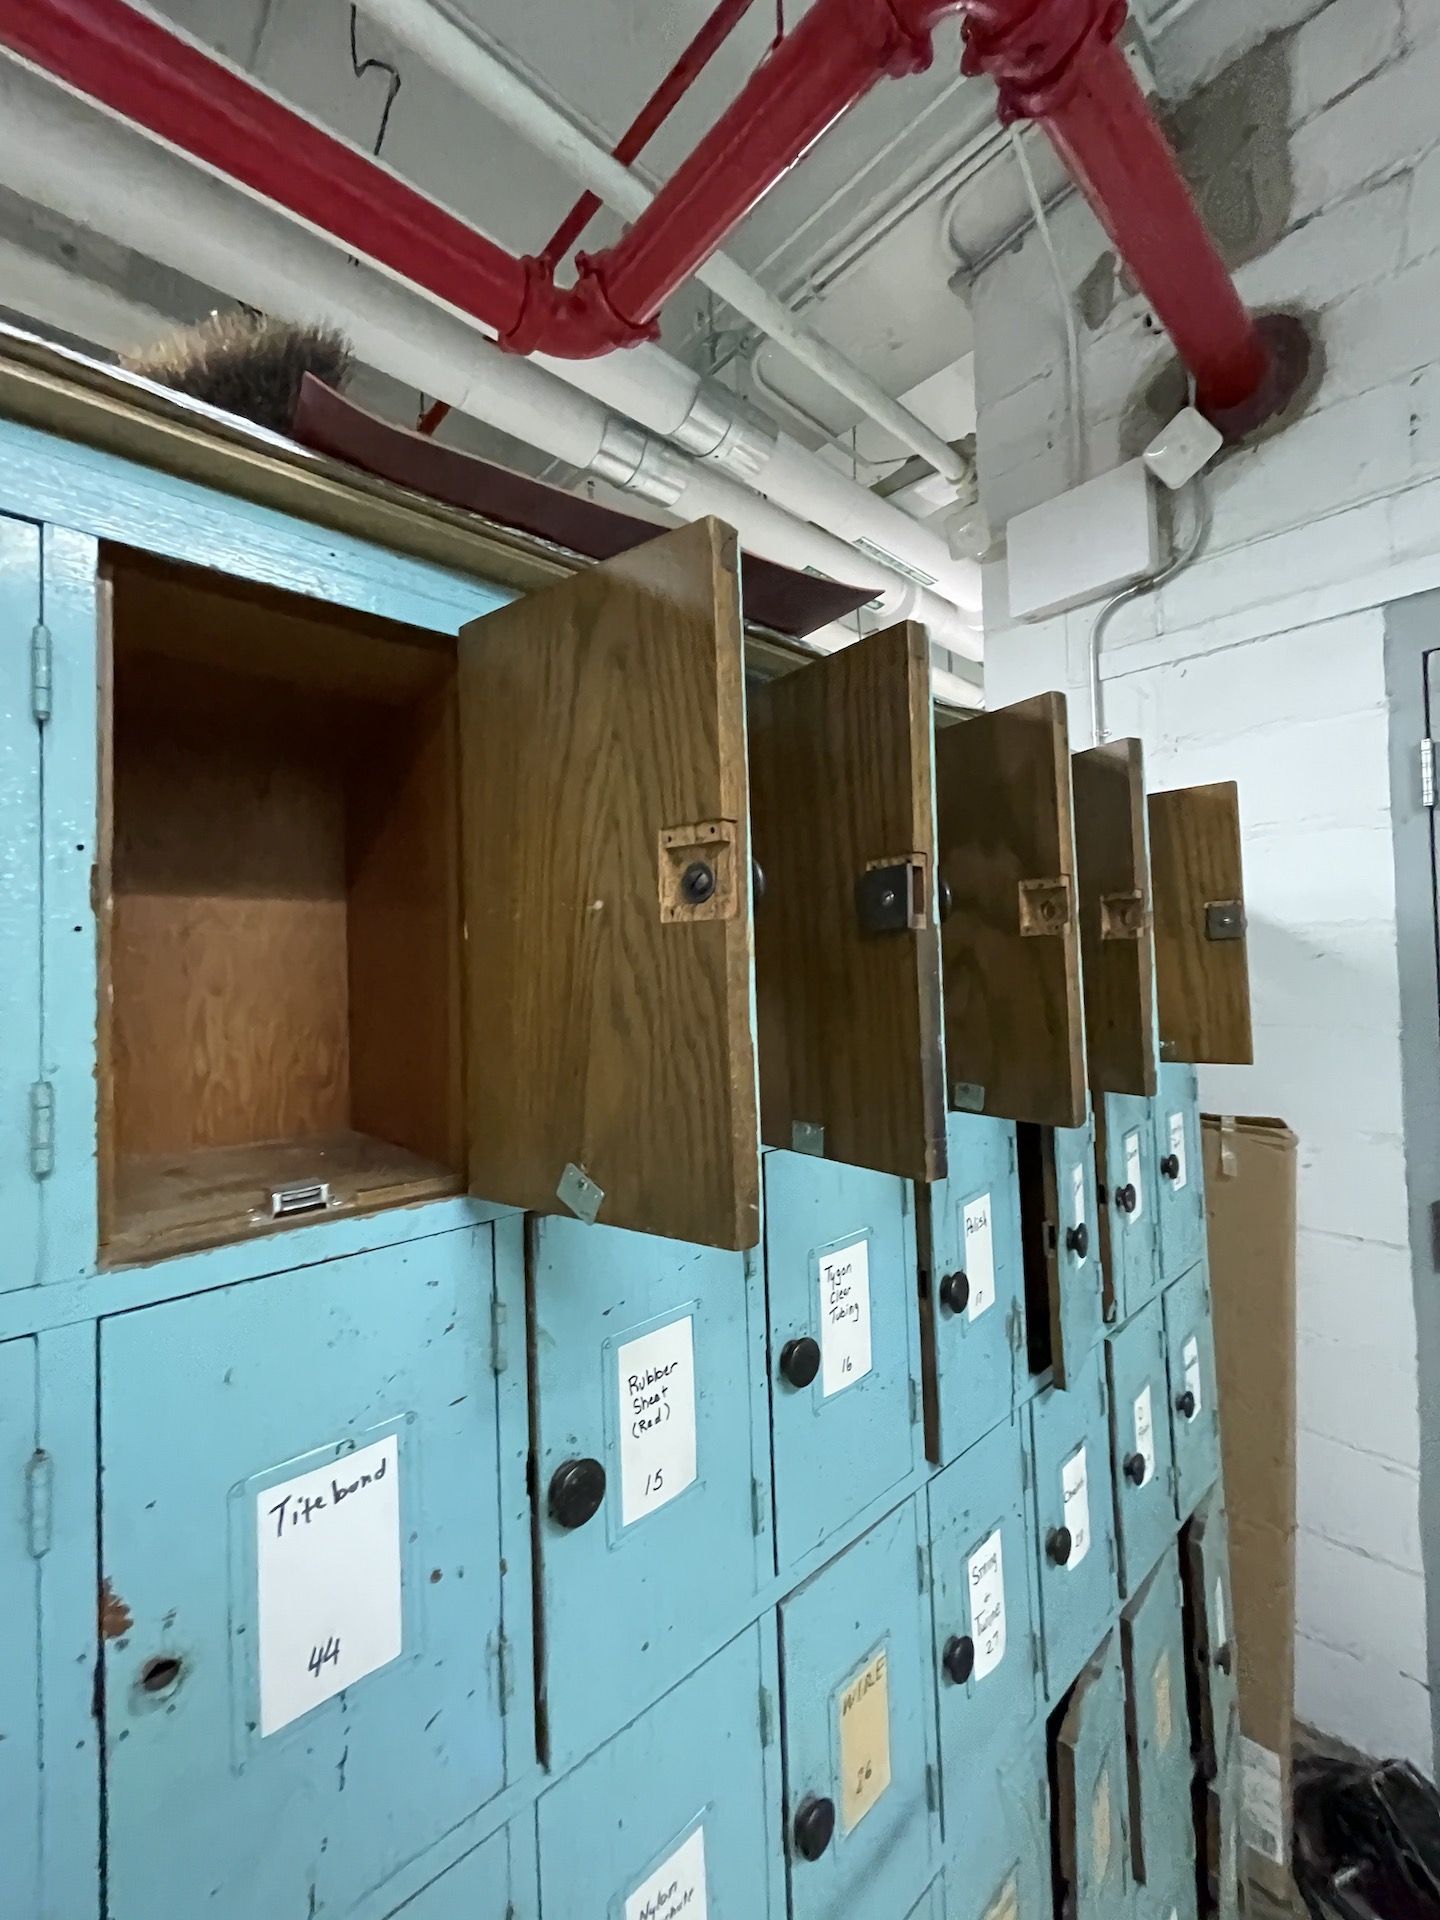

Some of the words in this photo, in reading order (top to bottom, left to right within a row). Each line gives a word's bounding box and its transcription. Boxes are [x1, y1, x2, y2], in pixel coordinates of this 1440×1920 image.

[824, 1262, 852, 1290] Tygon
[830, 1286, 851, 1305] Clear
[829, 1301, 859, 1325] Tubing
[627, 1361, 678, 1396] Rubber
[842, 1355, 853, 1374] 16
[632, 1403, 671, 1439] (Red)
[645, 1468, 664, 1496] 15
[307, 1636, 341, 1678] 44
[842, 1655, 886, 1717] WIRE
[856, 1760, 873, 1794] 26
